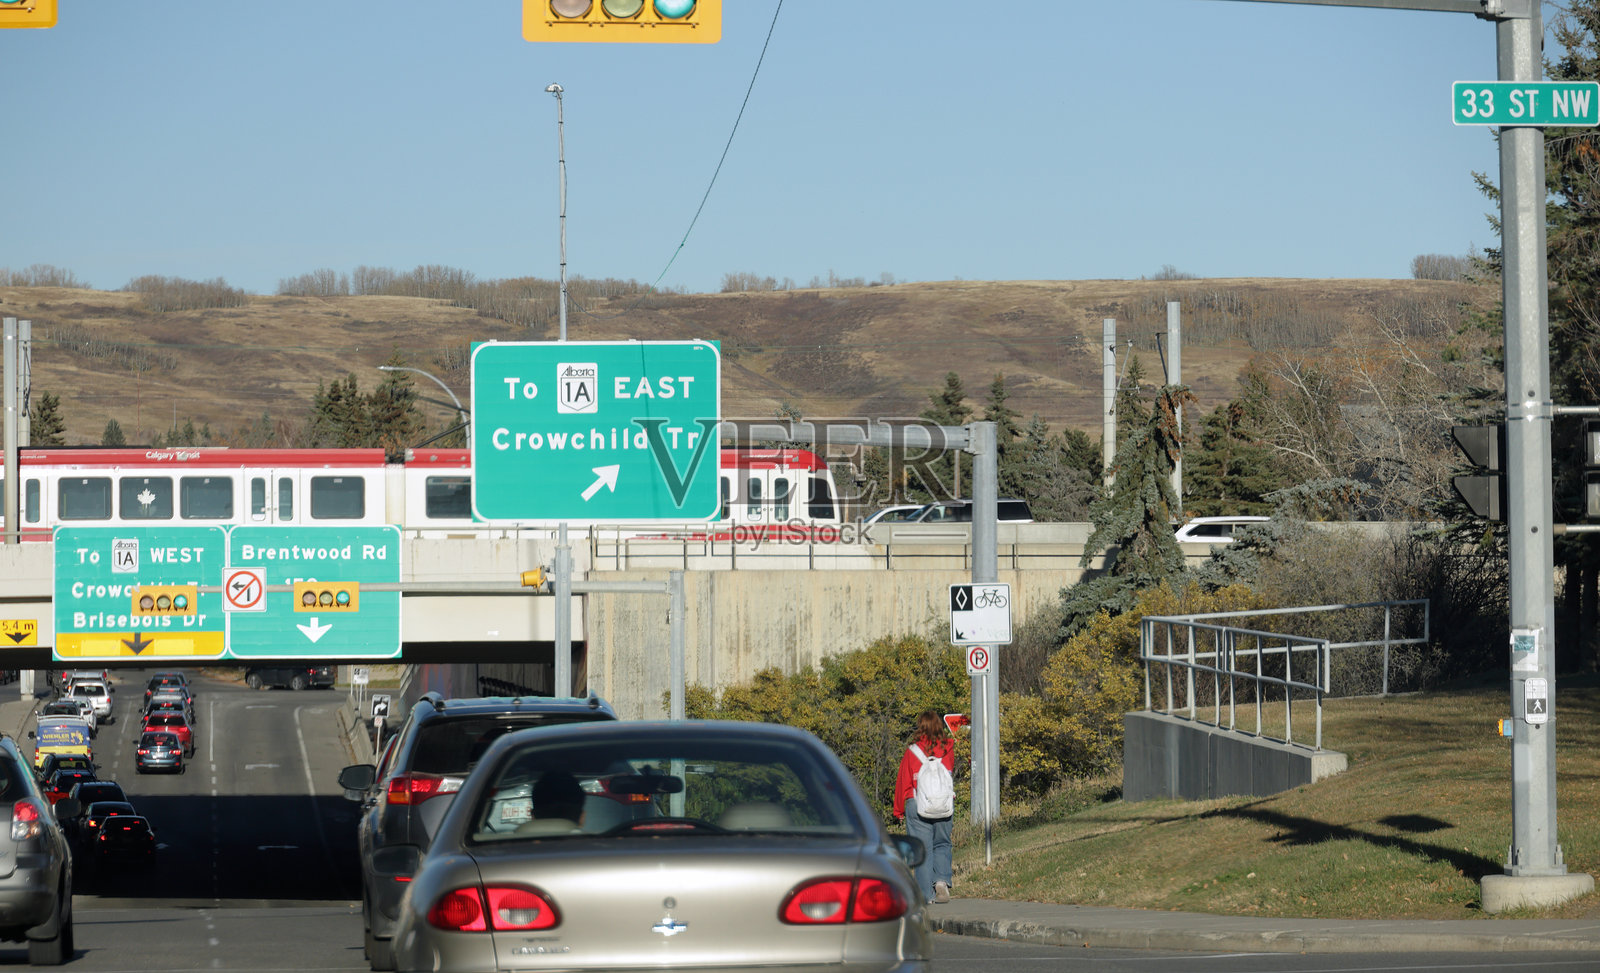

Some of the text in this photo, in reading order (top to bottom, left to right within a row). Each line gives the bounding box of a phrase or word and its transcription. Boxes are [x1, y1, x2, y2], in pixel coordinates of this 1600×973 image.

[1461, 89, 1591, 118] 33 ST NW
[561, 365, 595, 377] Alberta
[504, 376, 695, 402] To 1A EAST
[492, 427, 700, 451] Crowchild Tr
[145, 451, 201, 461] Calgary Tnsit
[114, 541, 138, 549] Alberta
[242, 544, 387, 560] Brentwood Rd
[77, 547, 205, 566] To 1A WEST
[2, 620, 34, 631] 5.4 m
[73, 612, 172, 629] Brisebois
[975, 651, 985, 665] P
